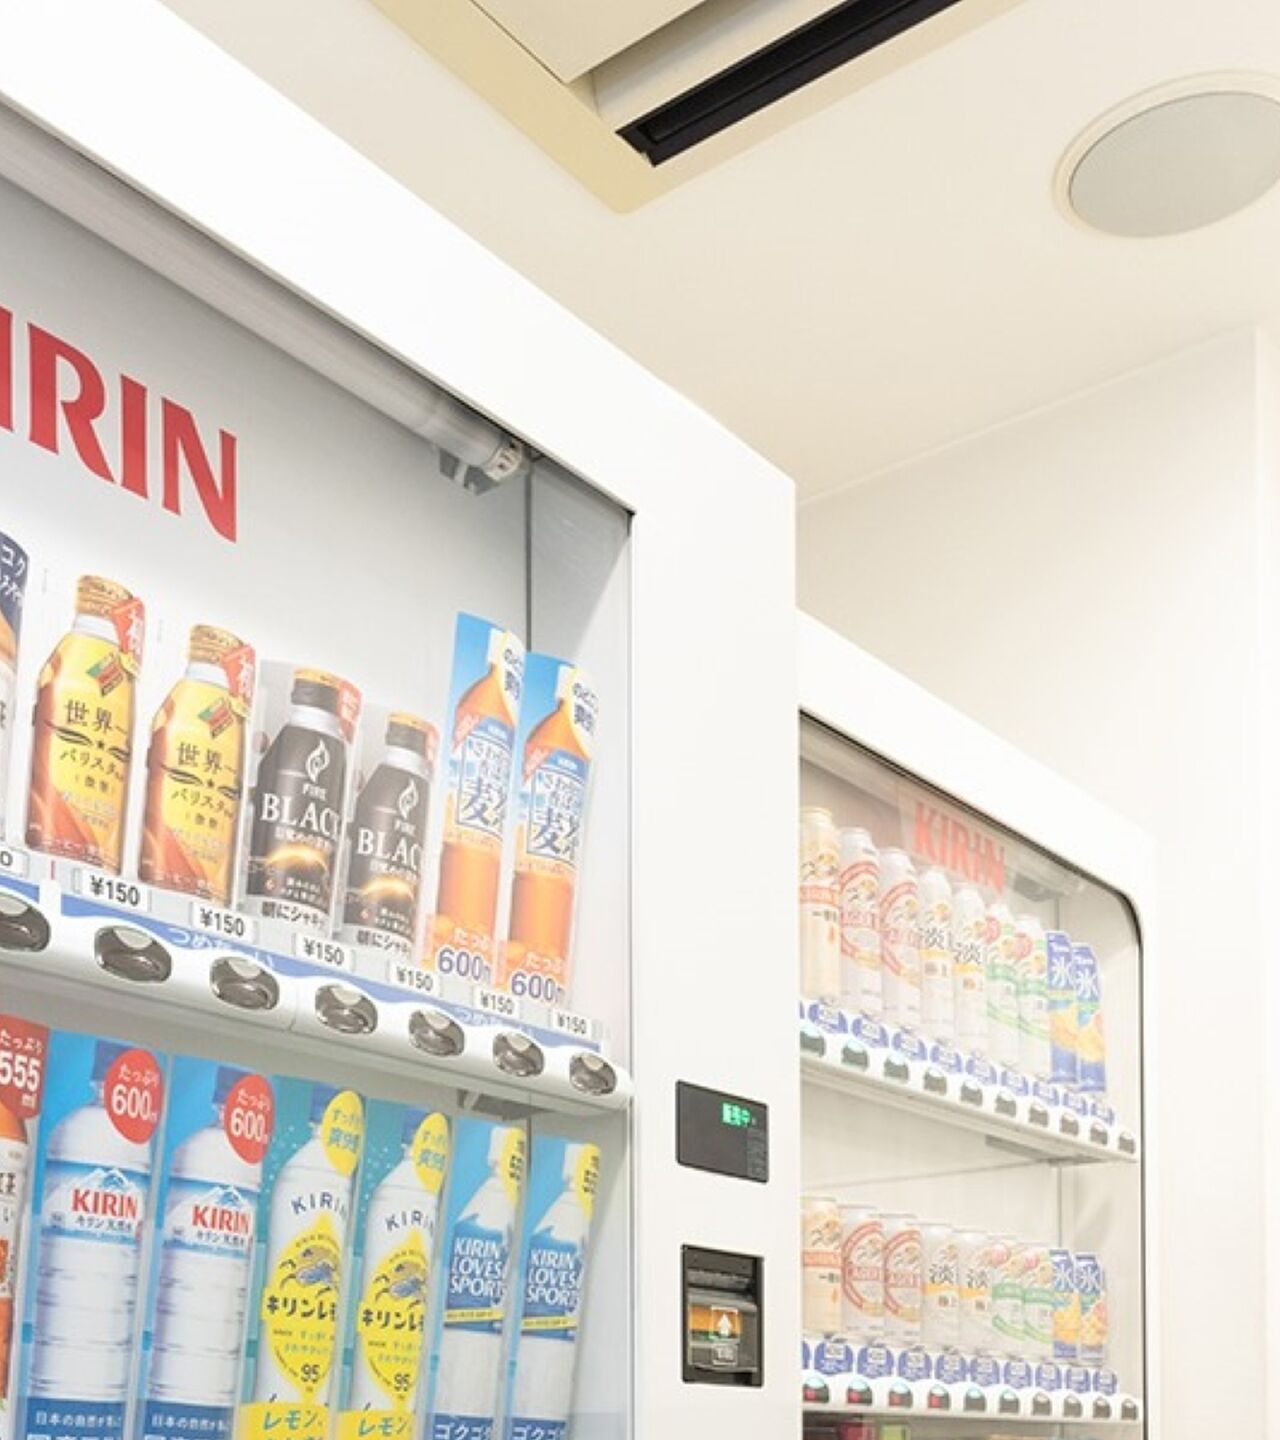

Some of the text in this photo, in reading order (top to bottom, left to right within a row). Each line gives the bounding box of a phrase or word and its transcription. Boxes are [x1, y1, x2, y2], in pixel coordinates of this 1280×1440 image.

[357, 828, 424, 871] BLAC
[913, 801, 1006, 894] KIRIN
[90, 874, 142, 908] ¥150
[199, 906, 246, 937] ¥150
[302, 935, 346, 966] ¥150
[395, 966, 434, 993] ¥150
[479, 990, 514, 1015] ¥150
[72, 1187, 138, 1220] KIRIN
[191, 1204, 251, 1235] KIRIN
[454, 1236, 500, 1260] KIRIN
[529, 1249, 575, 1270] KIRIN
[451, 1253, 504, 1280] LOVES
[528, 1267, 577, 1289] LOVES
[300, 1363, 321, 1384] 95
[393, 1372, 411, 1393] 95
